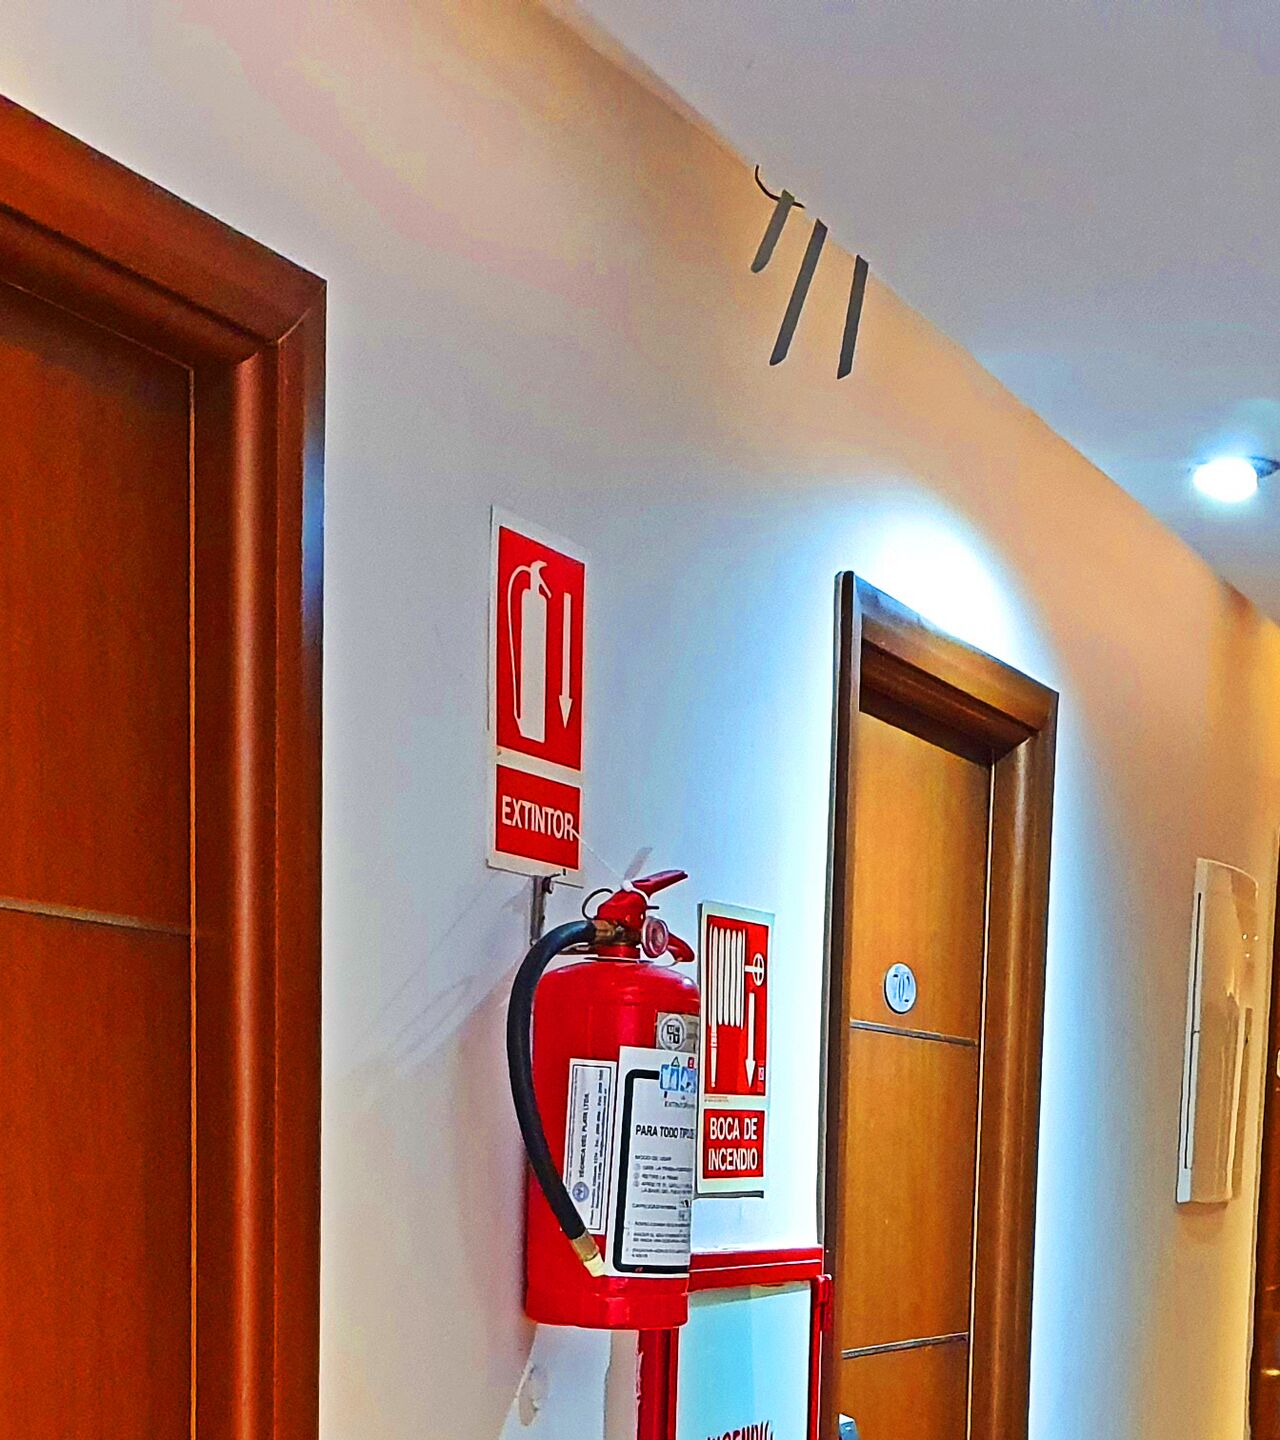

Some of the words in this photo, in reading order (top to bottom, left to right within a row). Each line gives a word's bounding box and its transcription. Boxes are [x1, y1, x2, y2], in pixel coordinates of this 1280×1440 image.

[502, 795, 574, 841] EXTINTOR
[635, 1124, 658, 1137] PARA
[660, 1126, 679, 1139] TODO
[709, 1117, 740, 1140] BOCA
[744, 1117, 758, 1140] DE
[708, 1147, 758, 1171] INCENDIO
